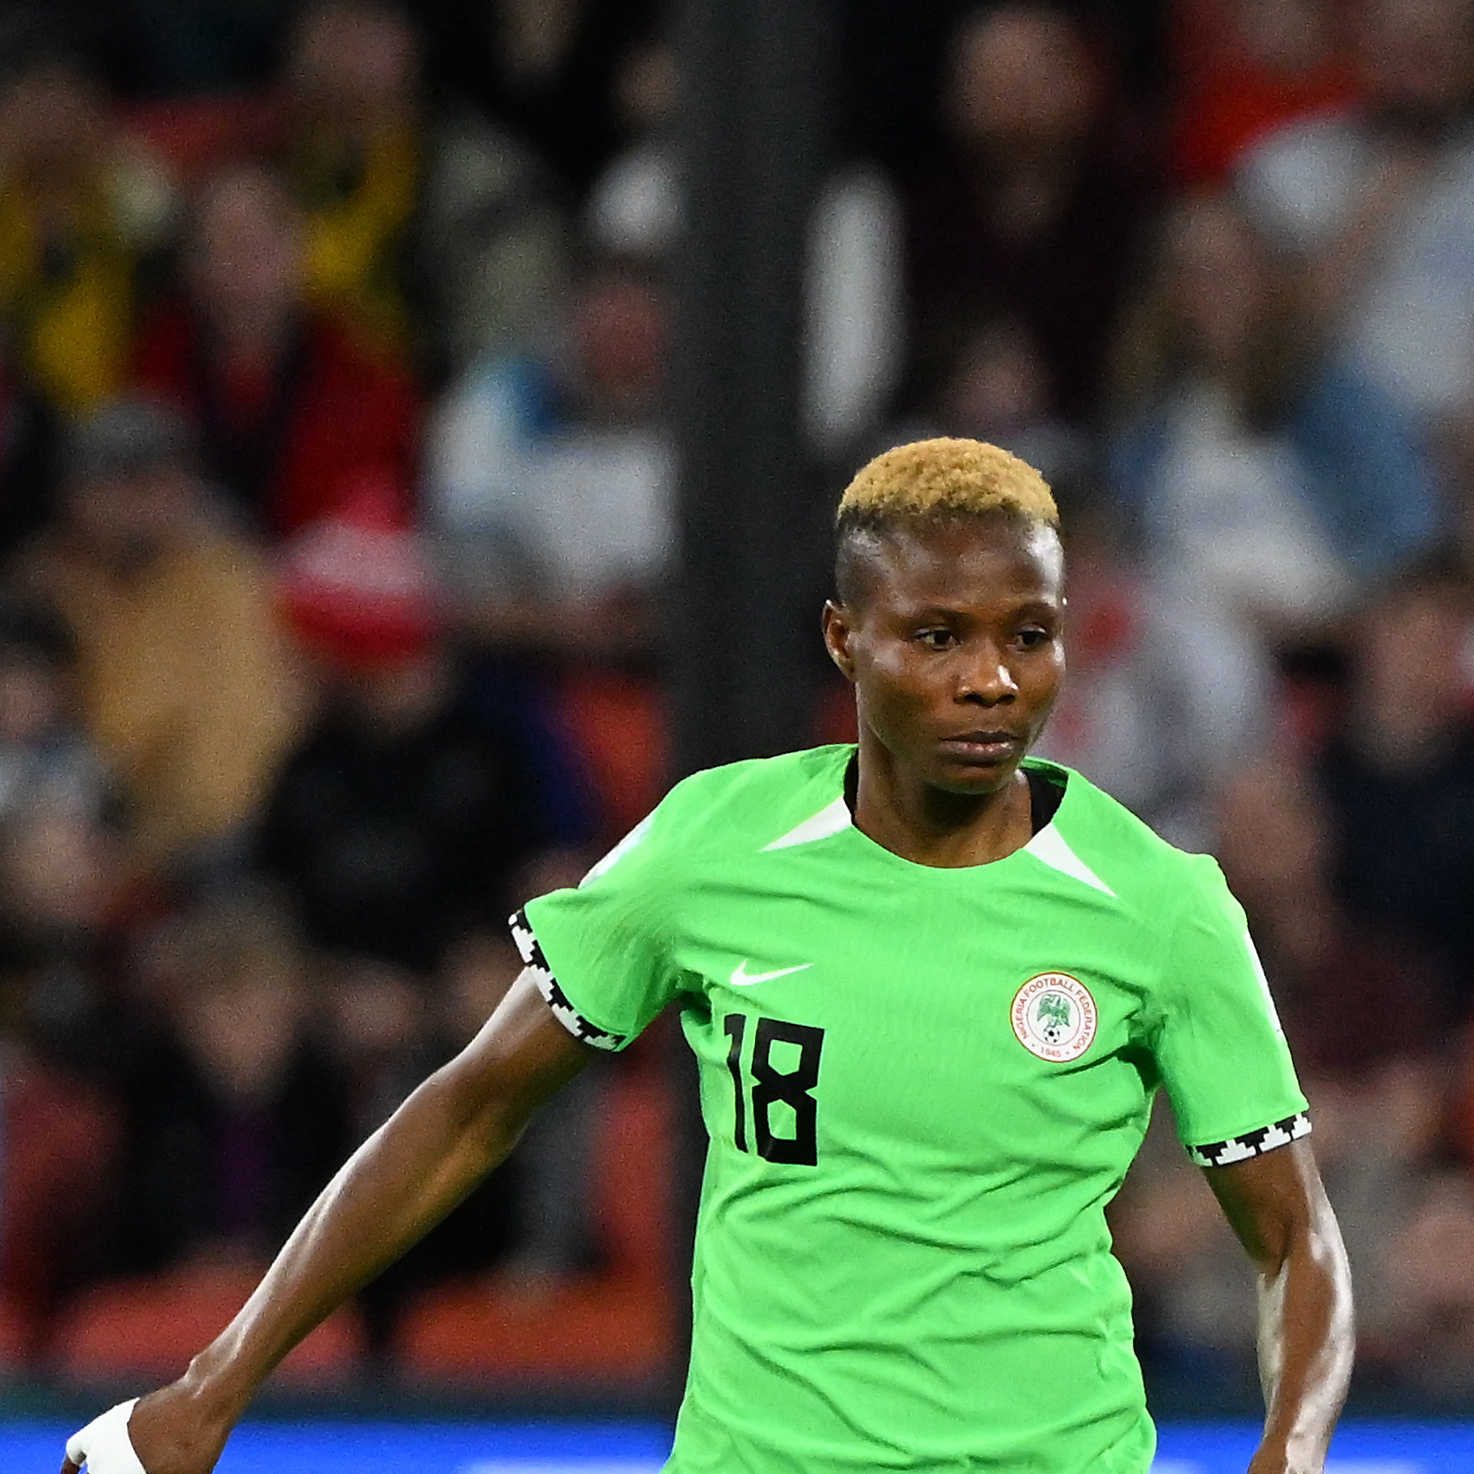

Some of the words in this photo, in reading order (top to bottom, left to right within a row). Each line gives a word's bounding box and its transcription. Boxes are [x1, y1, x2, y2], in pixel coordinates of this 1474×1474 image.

[1015, 998, 1028, 1040] NIGERIA
[1023, 977, 1075, 998] FOOTBALL
[1073, 989, 1093, 1050] FEDERATION
[724, 1013, 825, 1167] 18
